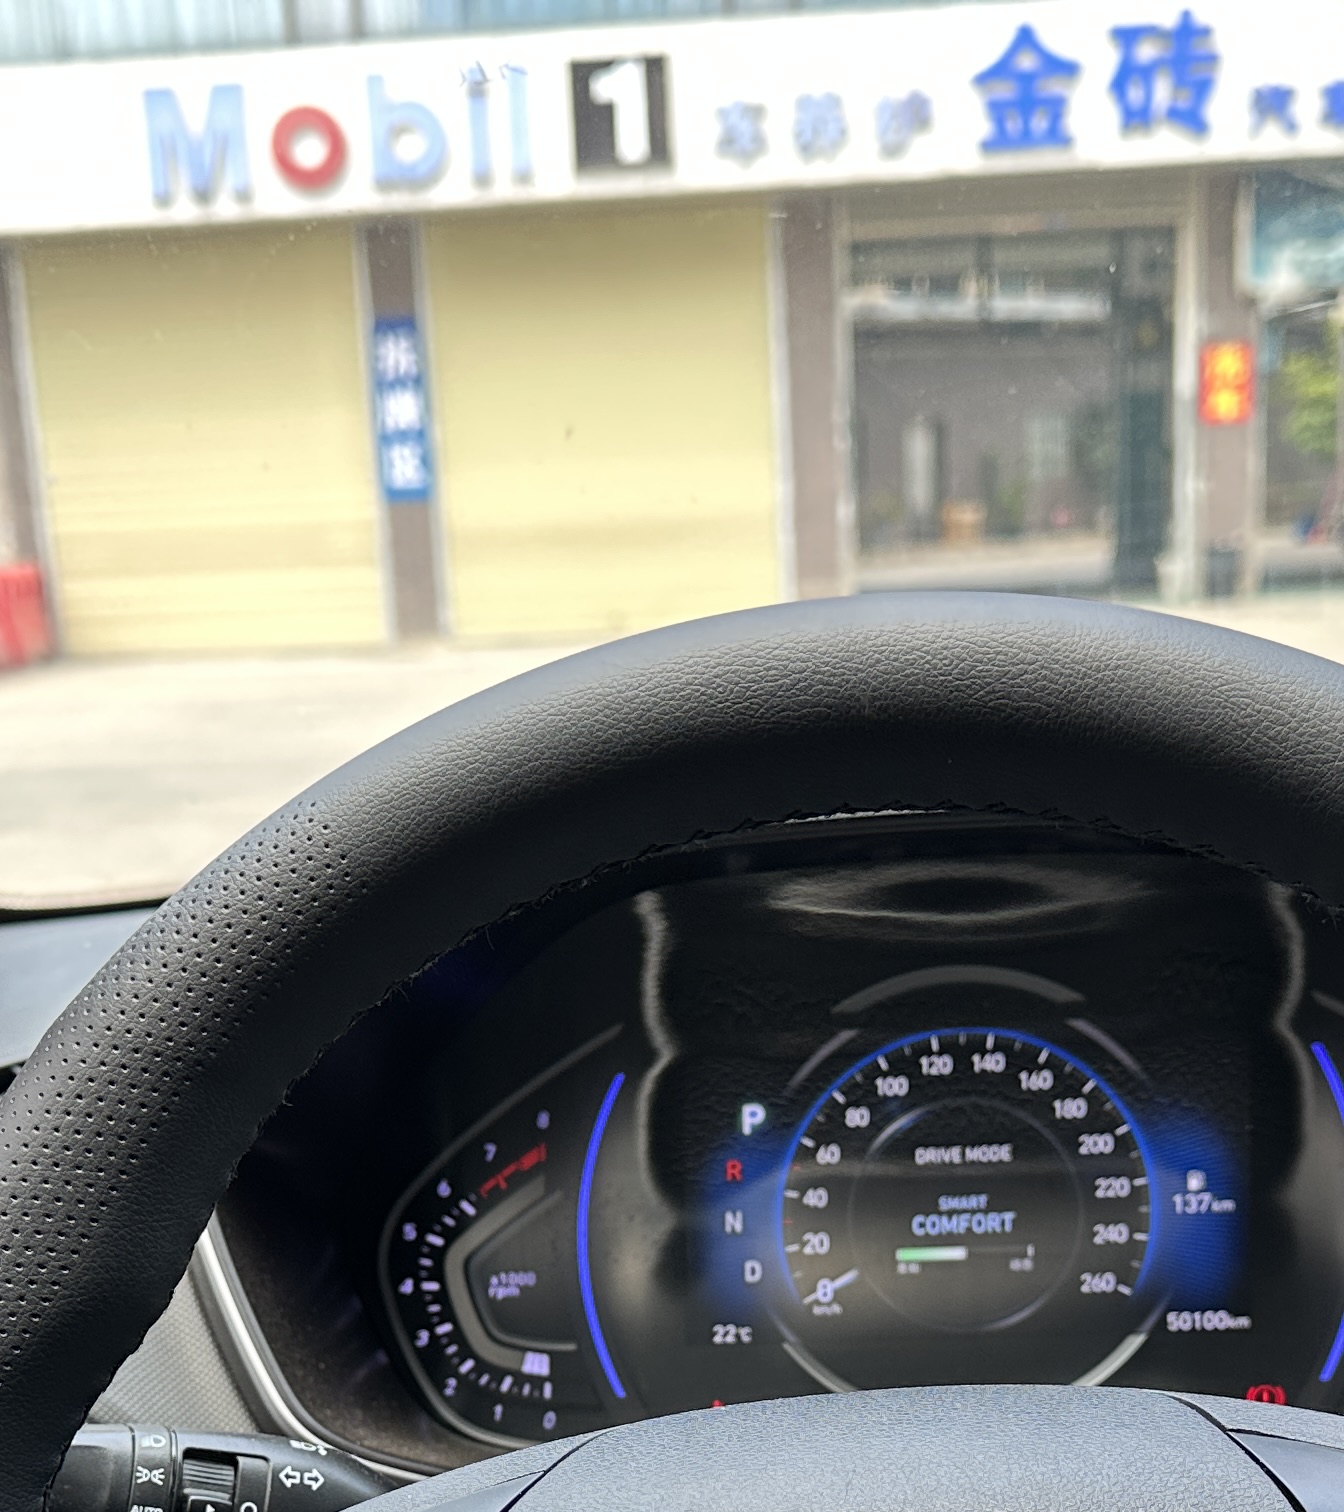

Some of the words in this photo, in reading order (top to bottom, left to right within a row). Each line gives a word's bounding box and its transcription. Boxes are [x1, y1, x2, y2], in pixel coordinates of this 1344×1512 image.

[972, 10, 1220, 152] 金砖
[142, 62, 536, 208] Mobil
[586, 58, 651, 166] 1
[920, 1054, 953, 1076] 120
[972, 1052, 1006, 1072] 140
[876, 1076, 908, 1096] 100
[1020, 1070, 1053, 1090] 160
[845, 1107, 870, 1127] 80
[1054, 1098, 1087, 1118] 180
[741, 1102, 767, 1137] P
[816, 1144, 840, 1165] 60
[913, 1144, 964, 1166] DRIVE
[965, 1142, 1014, 1164] MODE
[1079, 1134, 1114, 1154] 200
[724, 1158, 744, 1182] R
[803, 1188, 828, 1207] 40
[1095, 1177, 1130, 1198] 220
[724, 1210, 744, 1235] N
[910, 1210, 1020, 1238] COMFORT
[803, 1233, 829, 1254] 20
[1094, 1224, 1128, 1244] 240
[743, 1259, 763, 1284] D
[1081, 1272, 1117, 1292] 260
[398, 1277, 415, 1296] 4
[414, 1328, 431, 1348] 3
[443, 1376, 458, 1397] 2
